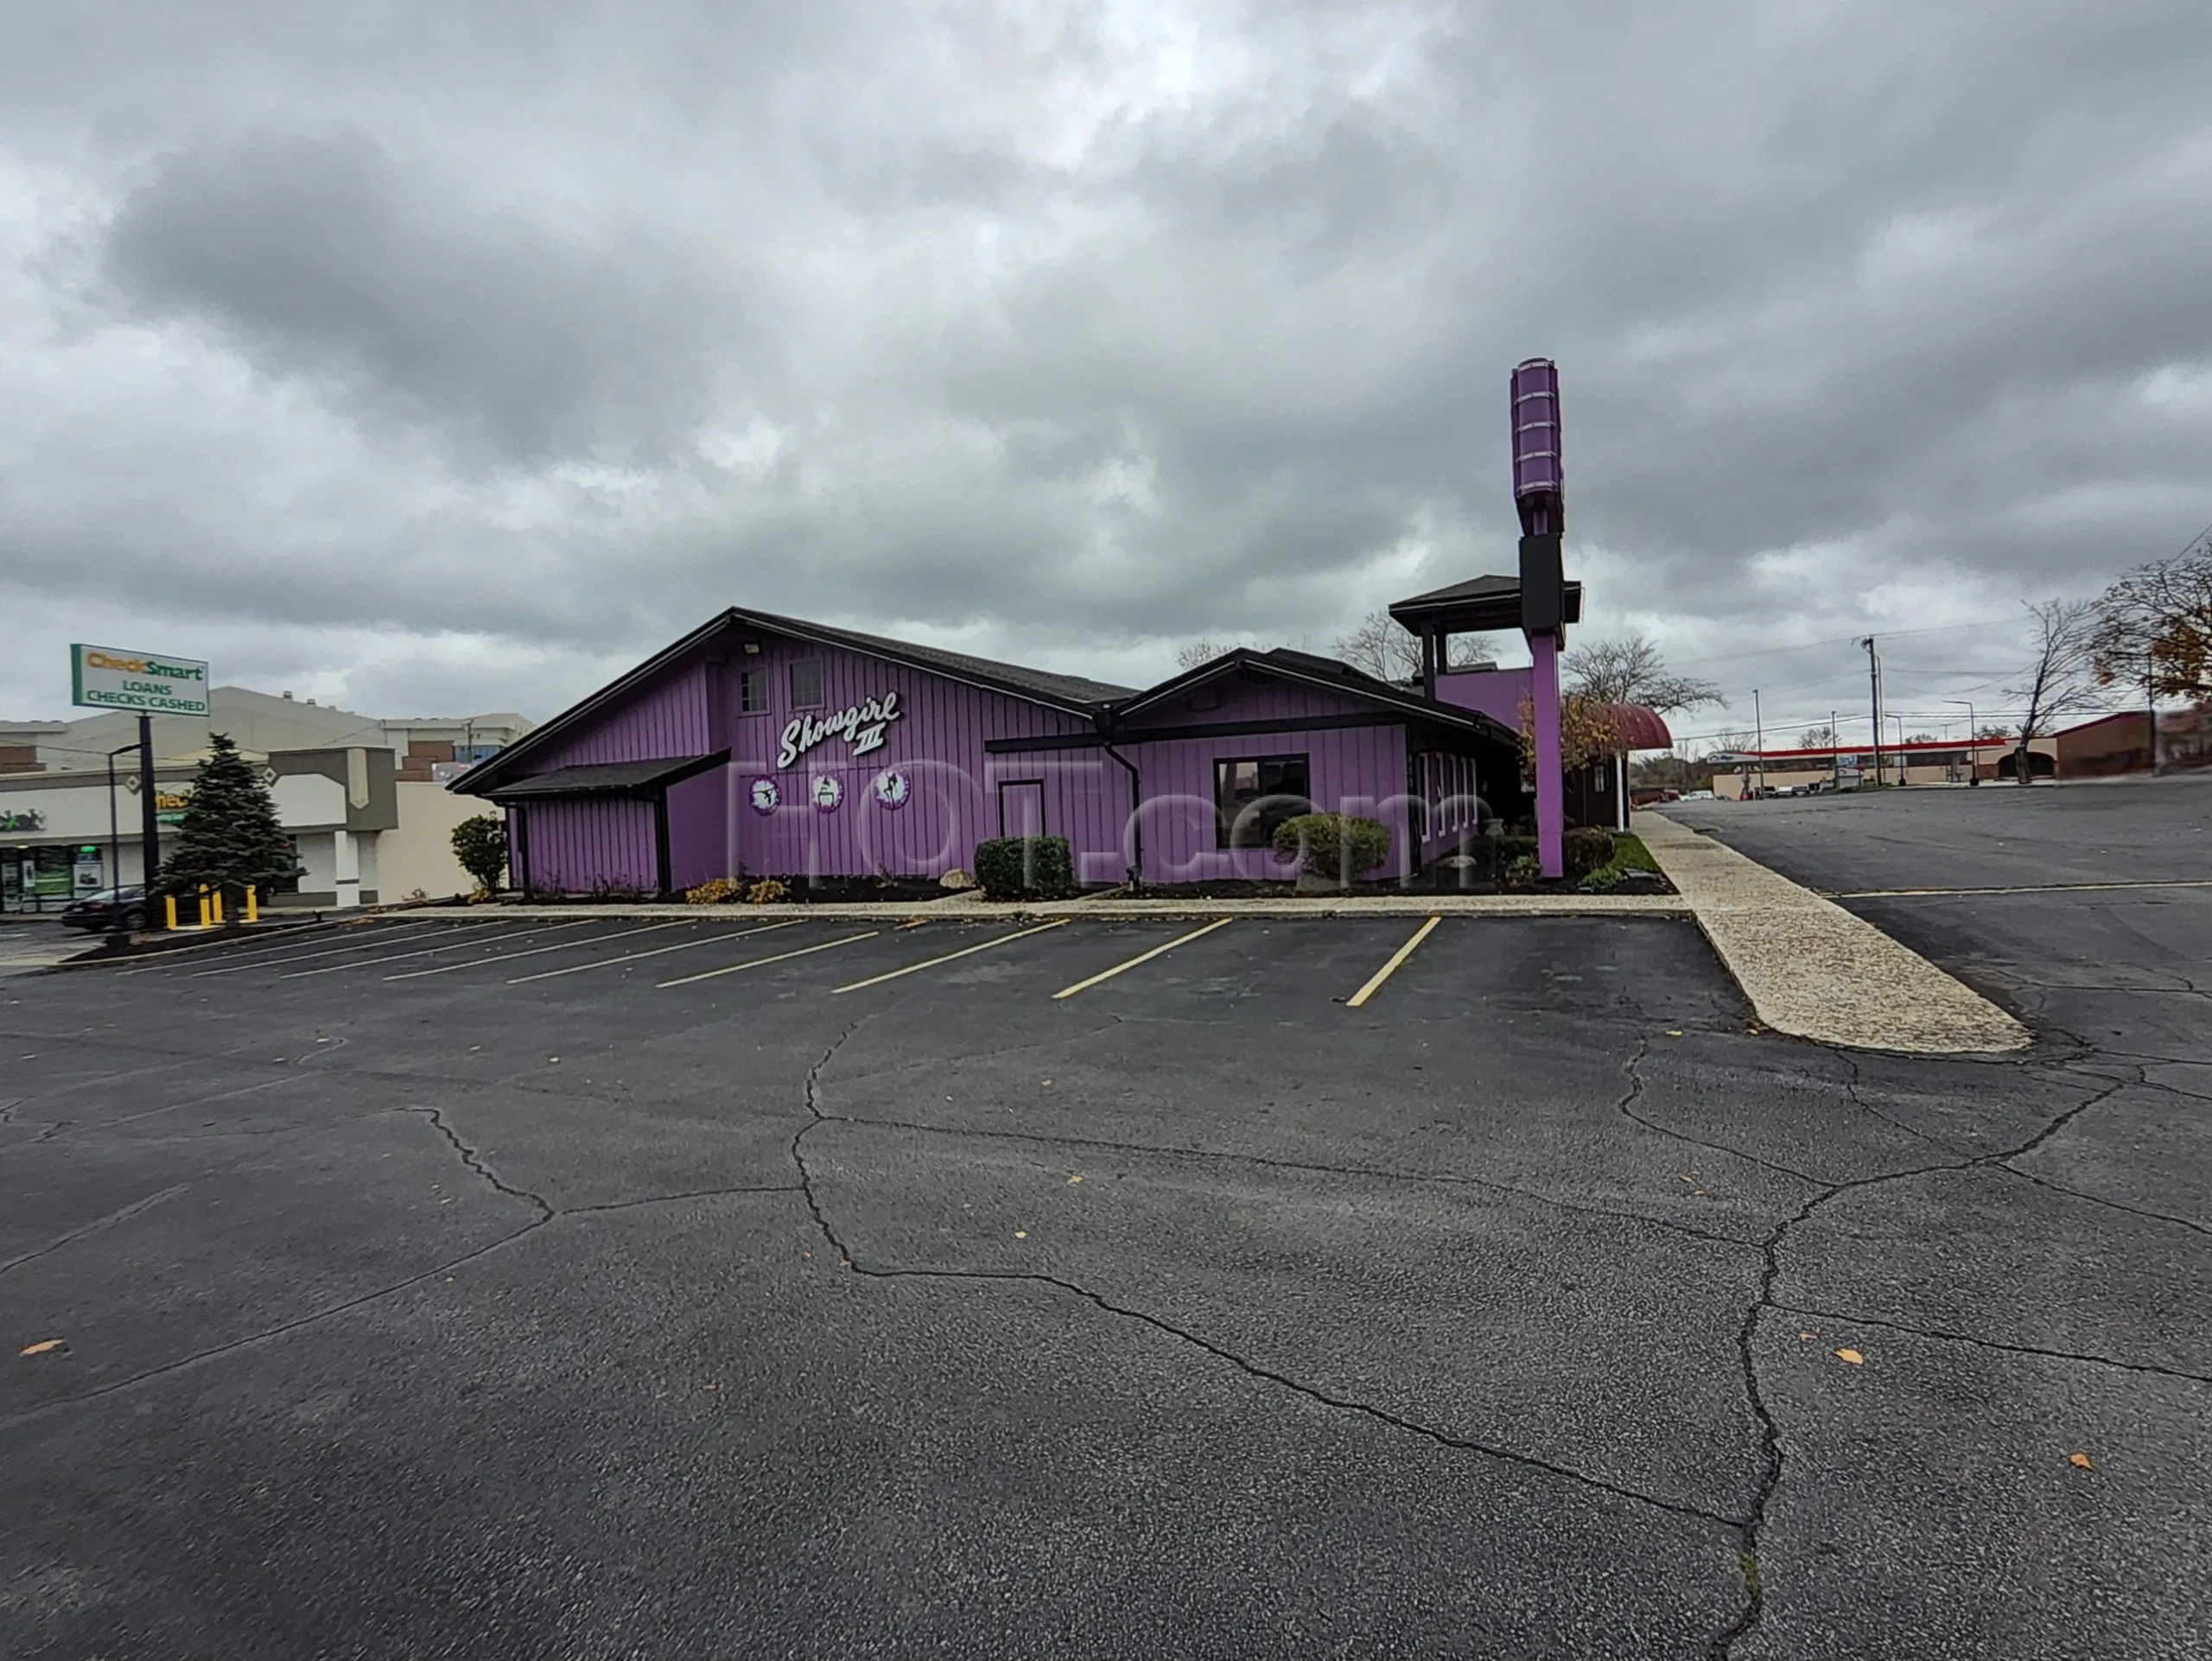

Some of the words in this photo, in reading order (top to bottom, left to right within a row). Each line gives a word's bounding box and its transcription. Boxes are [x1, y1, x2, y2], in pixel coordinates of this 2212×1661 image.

[86, 652, 204, 682] CheckSmart
[86, 690, 146, 706] CHECKS
[149, 697, 206, 712] CASHED
[123, 679, 173, 696] LOANS
[777, 691, 900, 769] Showgirl
[852, 722, 887, 756] III
